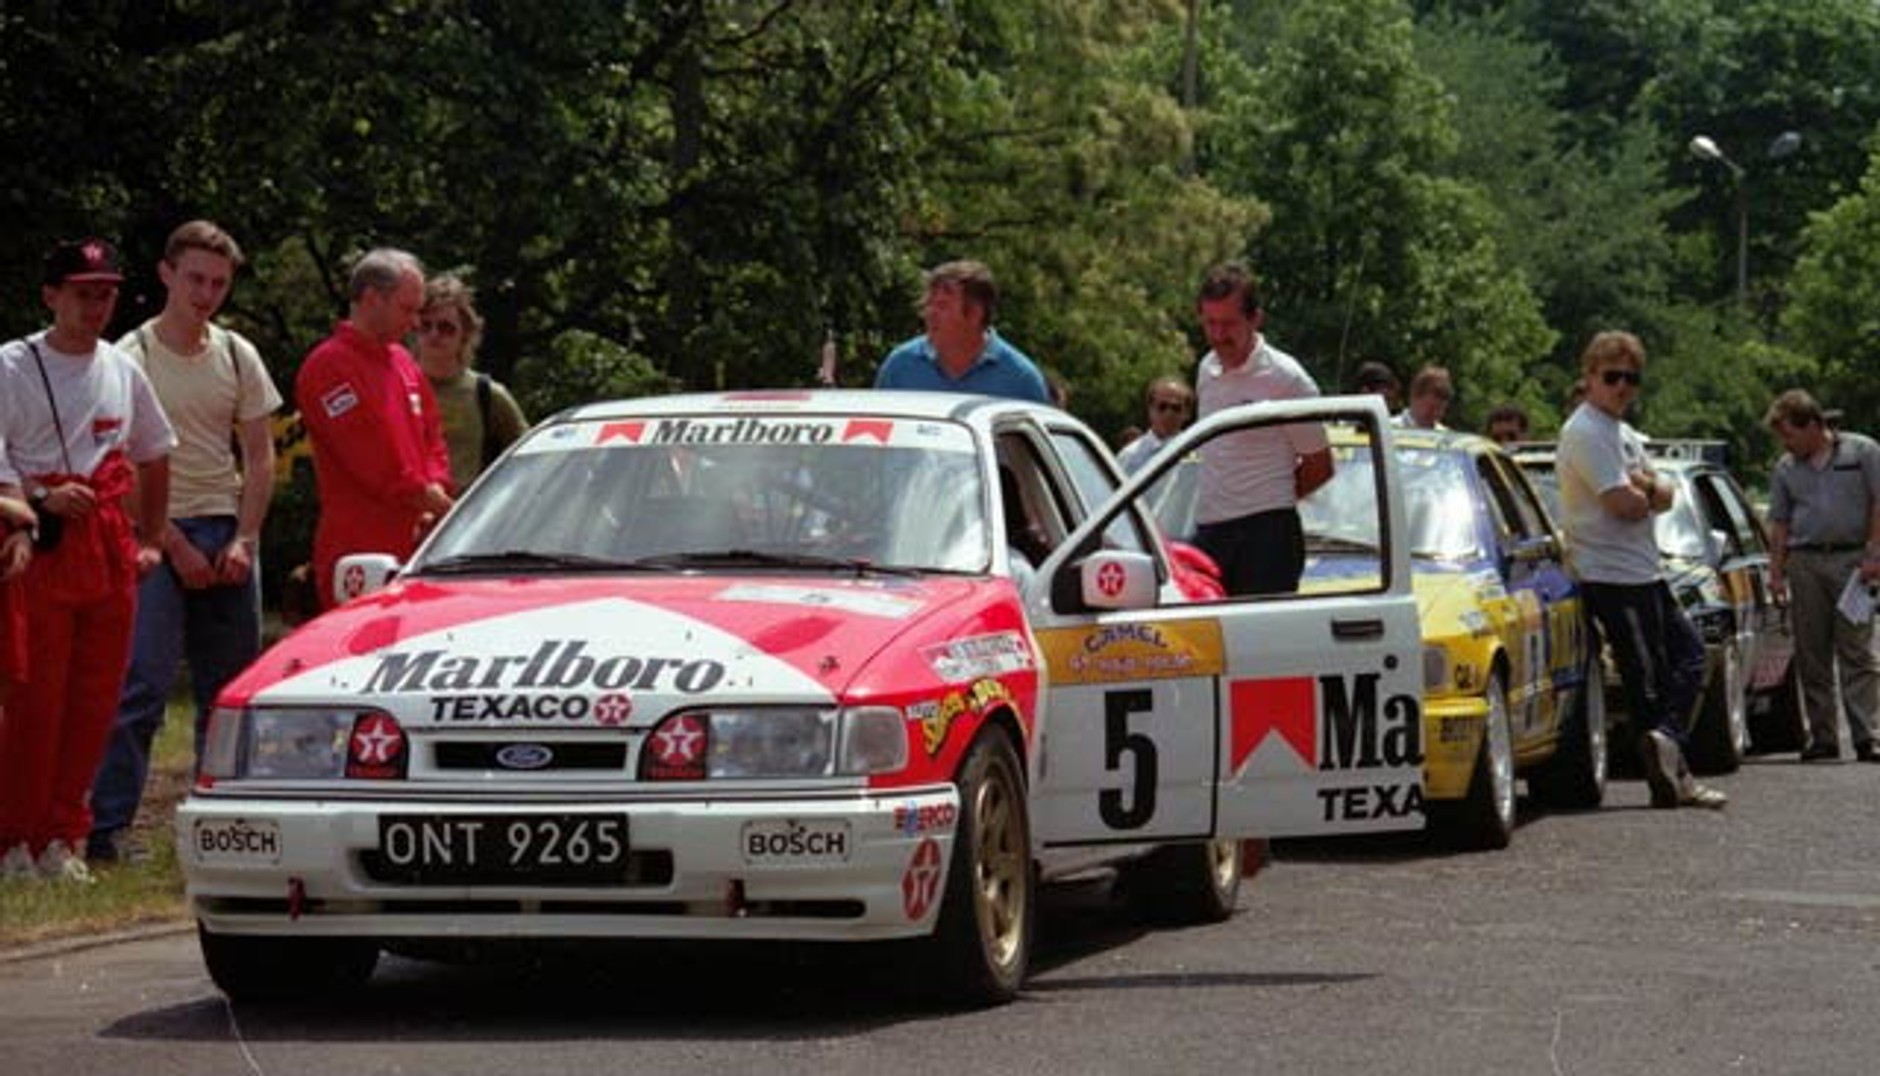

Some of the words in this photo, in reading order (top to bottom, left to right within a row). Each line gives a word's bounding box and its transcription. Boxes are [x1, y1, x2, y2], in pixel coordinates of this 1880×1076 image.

[651, 419, 833, 444] Marlboro
[1083, 623, 1168, 652] CAMEL
[360, 641, 725, 694] Marlboro
[430, 695, 589, 721] TEXACO
[1318, 673, 1425, 769] Ma
[1098, 688, 1158, 830] 5
[1317, 784, 1425, 821] TEXA
[200, 828, 277, 854] BOSCH
[386, 823, 483, 864] ONT
[507, 821, 622, 864] 9265
[749, 832, 845, 855] BOSCH
